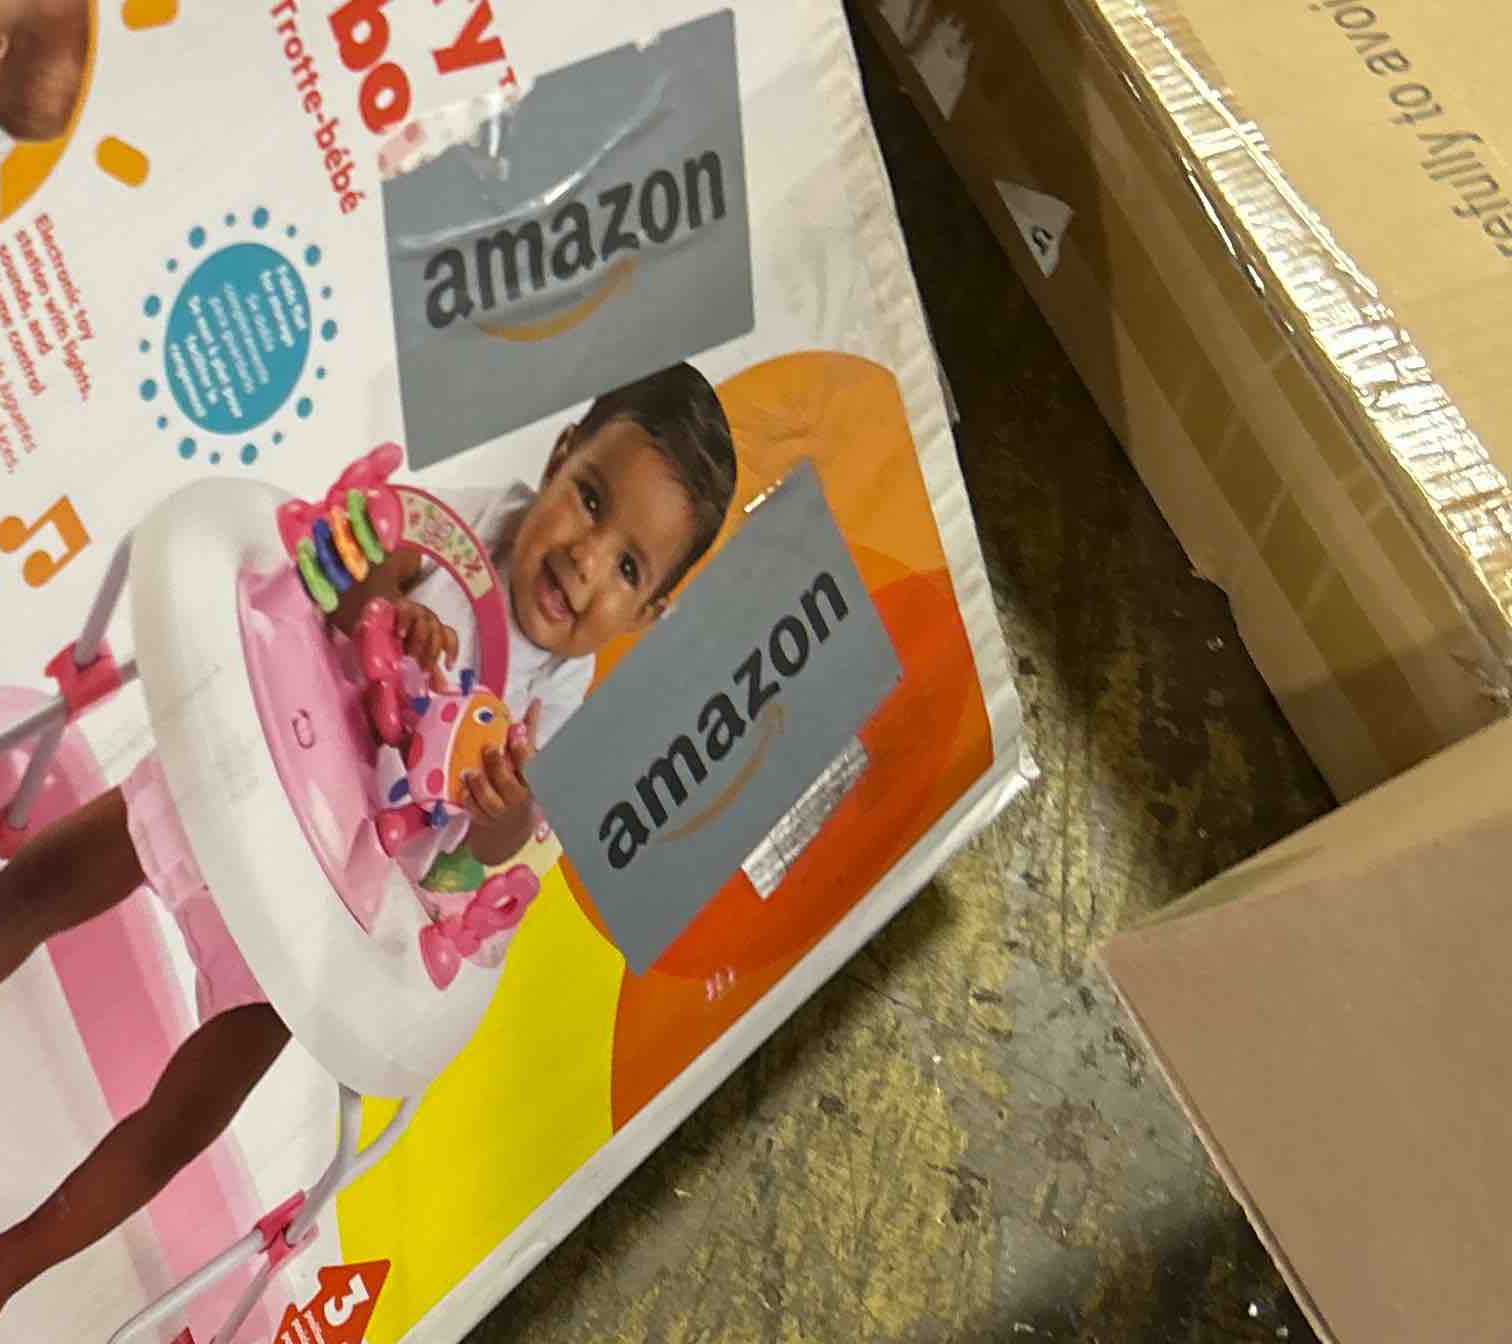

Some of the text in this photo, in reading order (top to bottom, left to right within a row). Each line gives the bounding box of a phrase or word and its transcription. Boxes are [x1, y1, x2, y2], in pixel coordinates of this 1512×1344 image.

[1388, 83, 1444, 129] to
[34, 213, 94, 341] Electronic toy
[422, 149, 727, 330] amazon
[8, 330, 47, 396] control
[15, 229, 91, 401] station with lights,
[28, 320, 53, 356] and
[596, 569, 849, 869] amazon
[324, 1275, 370, 1327] 3
